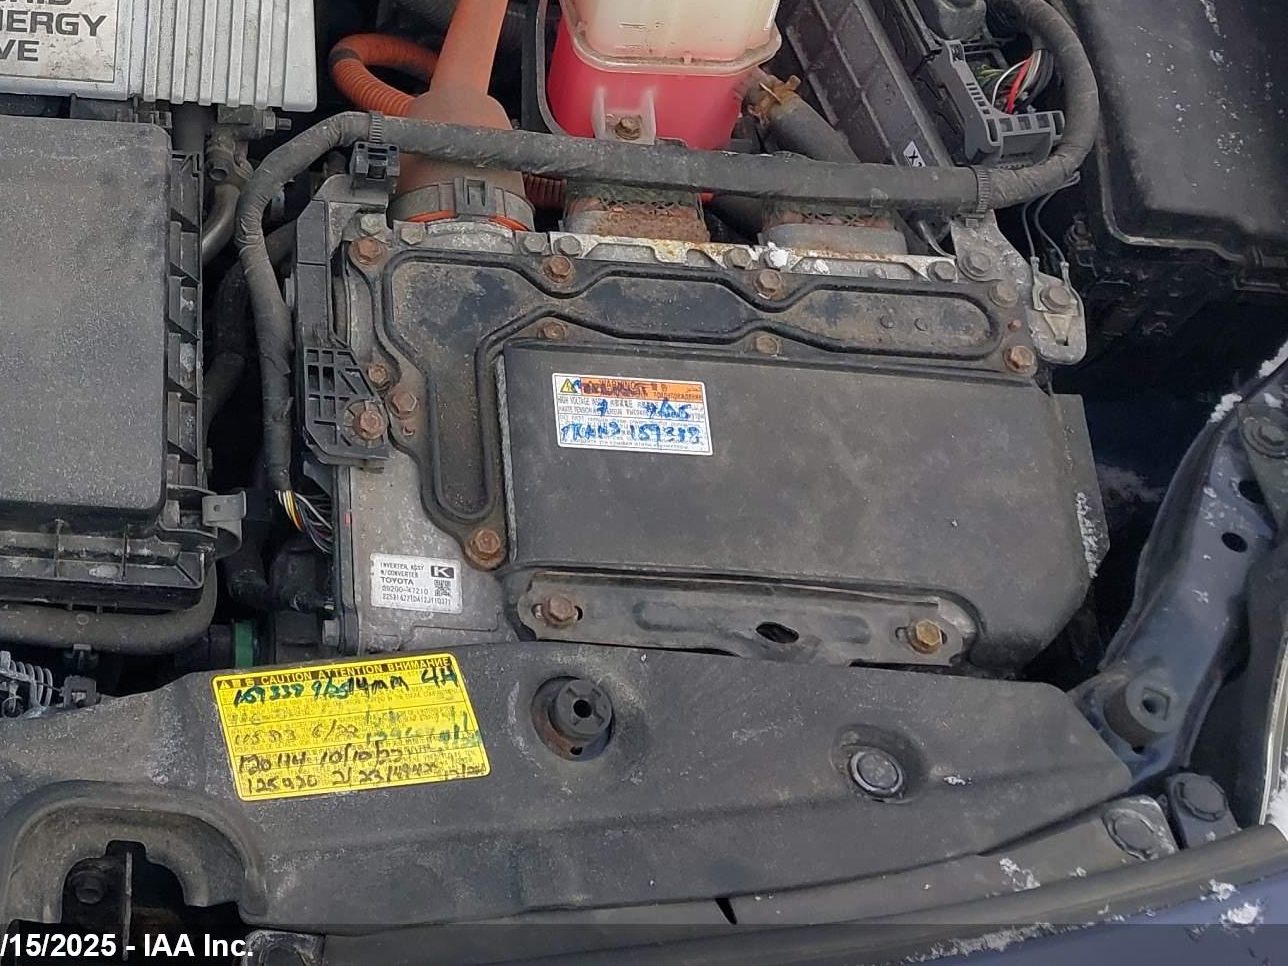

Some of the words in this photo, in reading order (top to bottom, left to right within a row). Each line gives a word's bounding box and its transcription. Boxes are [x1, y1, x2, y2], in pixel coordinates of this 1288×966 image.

[380, 576, 415, 585] TOYOTA
[387, 658, 451, 673] ВНИМАНИЕ
[260, 672, 312, 685] CAUTION
[318, 663, 384, 679] ATTENTION
